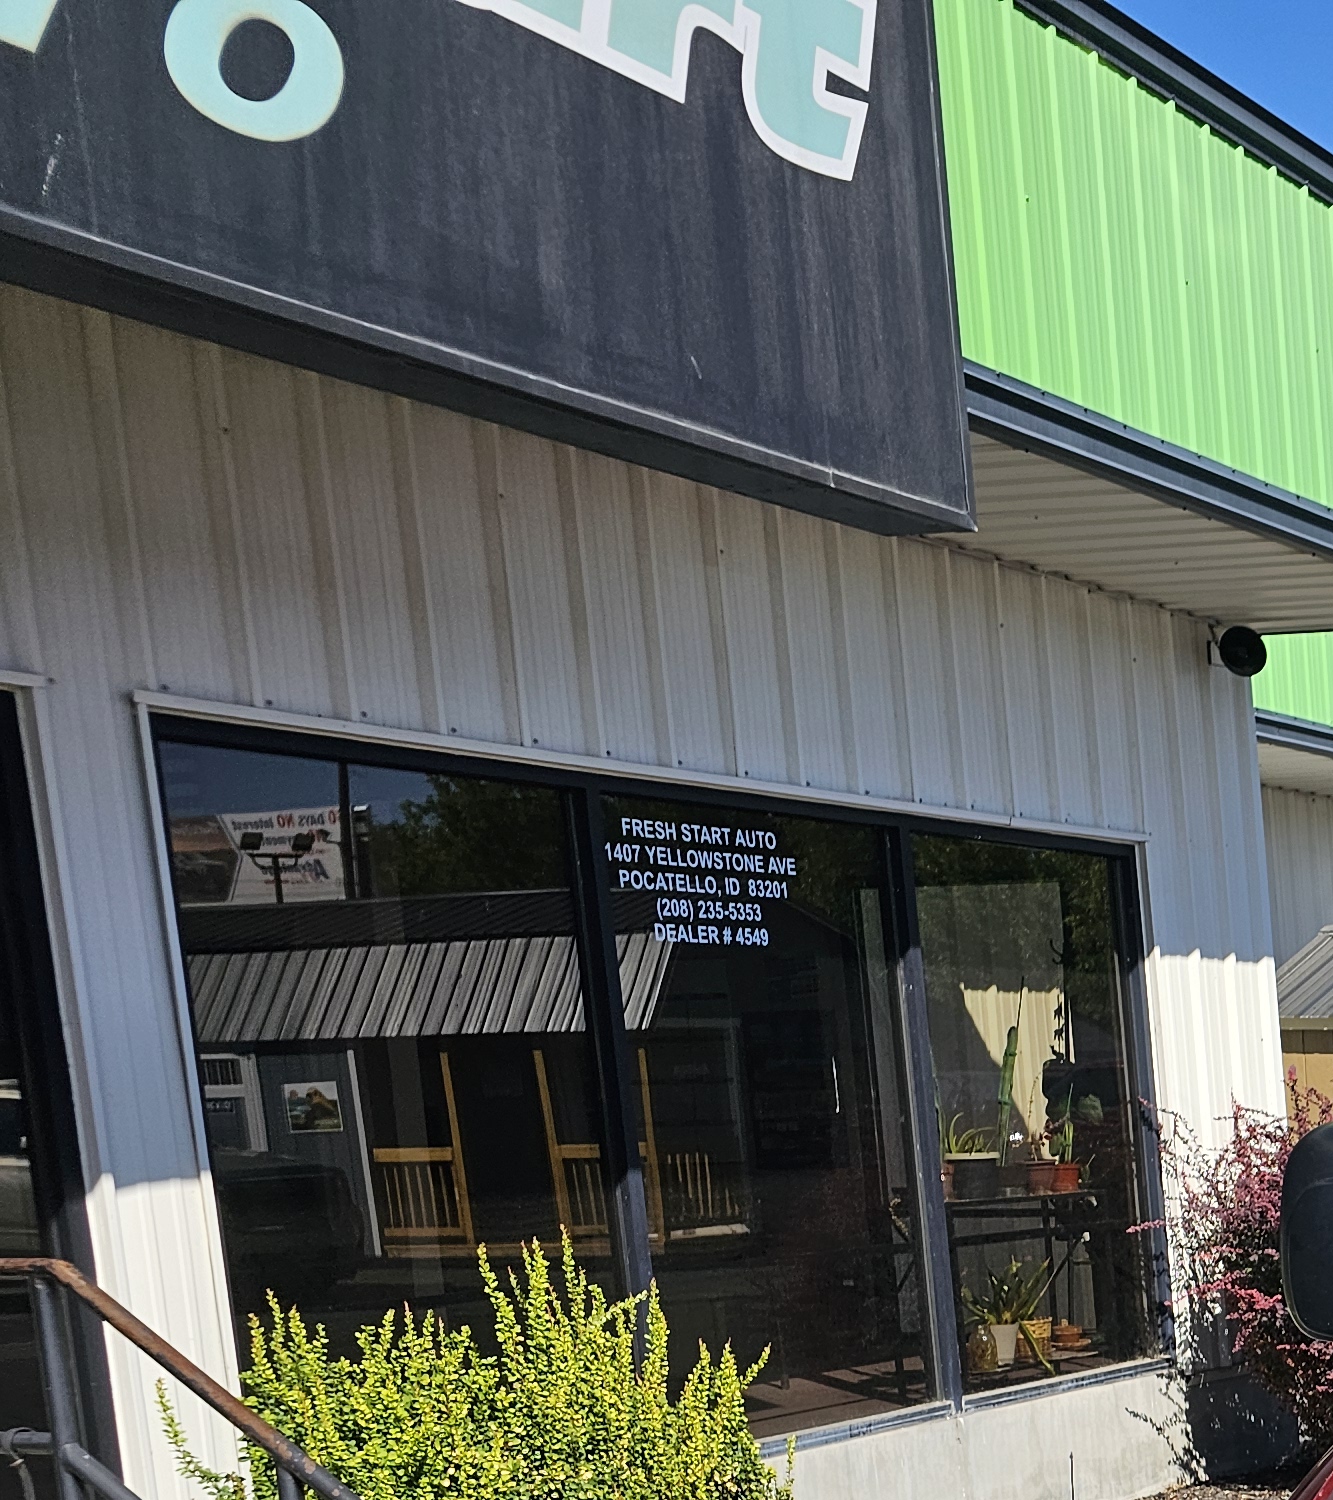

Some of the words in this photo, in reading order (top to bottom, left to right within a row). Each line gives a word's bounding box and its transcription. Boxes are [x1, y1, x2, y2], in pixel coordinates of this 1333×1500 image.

[621, 817, 677, 841] FRESH
[681, 823, 731, 846] START
[735, 828, 777, 850] AUTO
[604, 842, 640, 863] 1407
[645, 845, 765, 873] YELLOWSTONE
[768, 856, 797, 876] AVE
[619, 869, 722, 897] POCATELLO,
[725, 877, 740, 896] ID
[748, 879, 788, 899] 83201
[656, 897, 694, 922] (208)
[698, 900, 762, 922] 235-5353
[654, 923, 720, 945] DEALER
[723, 926, 733, 945] #
[735, 928, 769, 947] 4549
